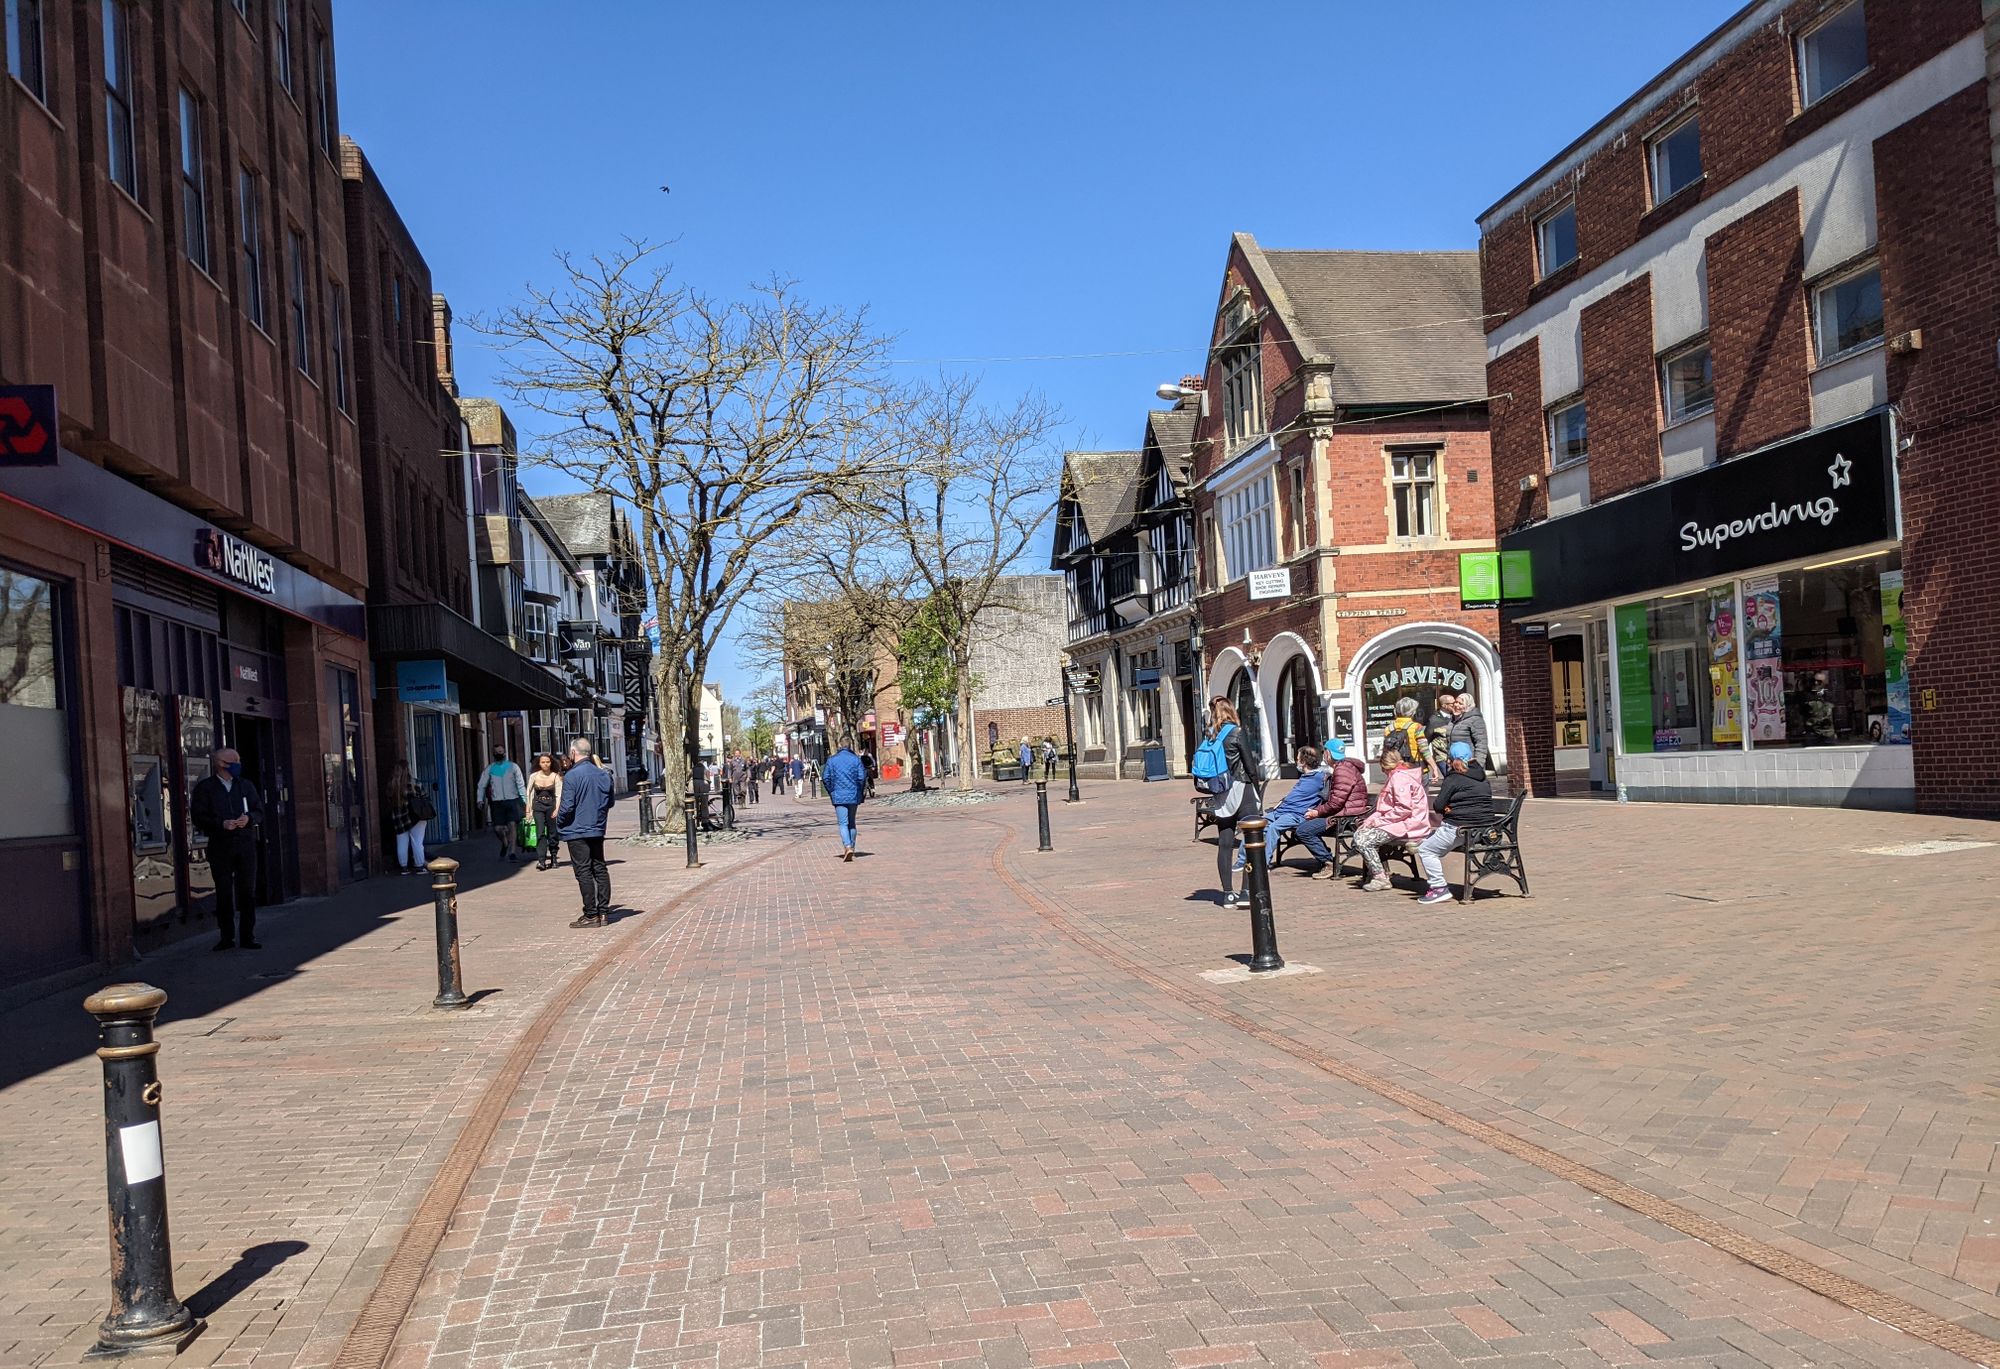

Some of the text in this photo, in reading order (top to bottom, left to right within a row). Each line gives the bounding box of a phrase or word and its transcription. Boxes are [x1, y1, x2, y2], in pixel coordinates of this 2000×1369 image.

[1680, 497, 1839, 551] Superdrug
[223, 534, 276, 594] NatWest
[1254, 572, 1285, 580] HARVEYS
[560, 631, 591, 653] Swan
[239, 665, 259, 682] NatWest
[1372, 666, 1467, 695] HARVEYS
[1336, 715, 1352, 730] ABC
